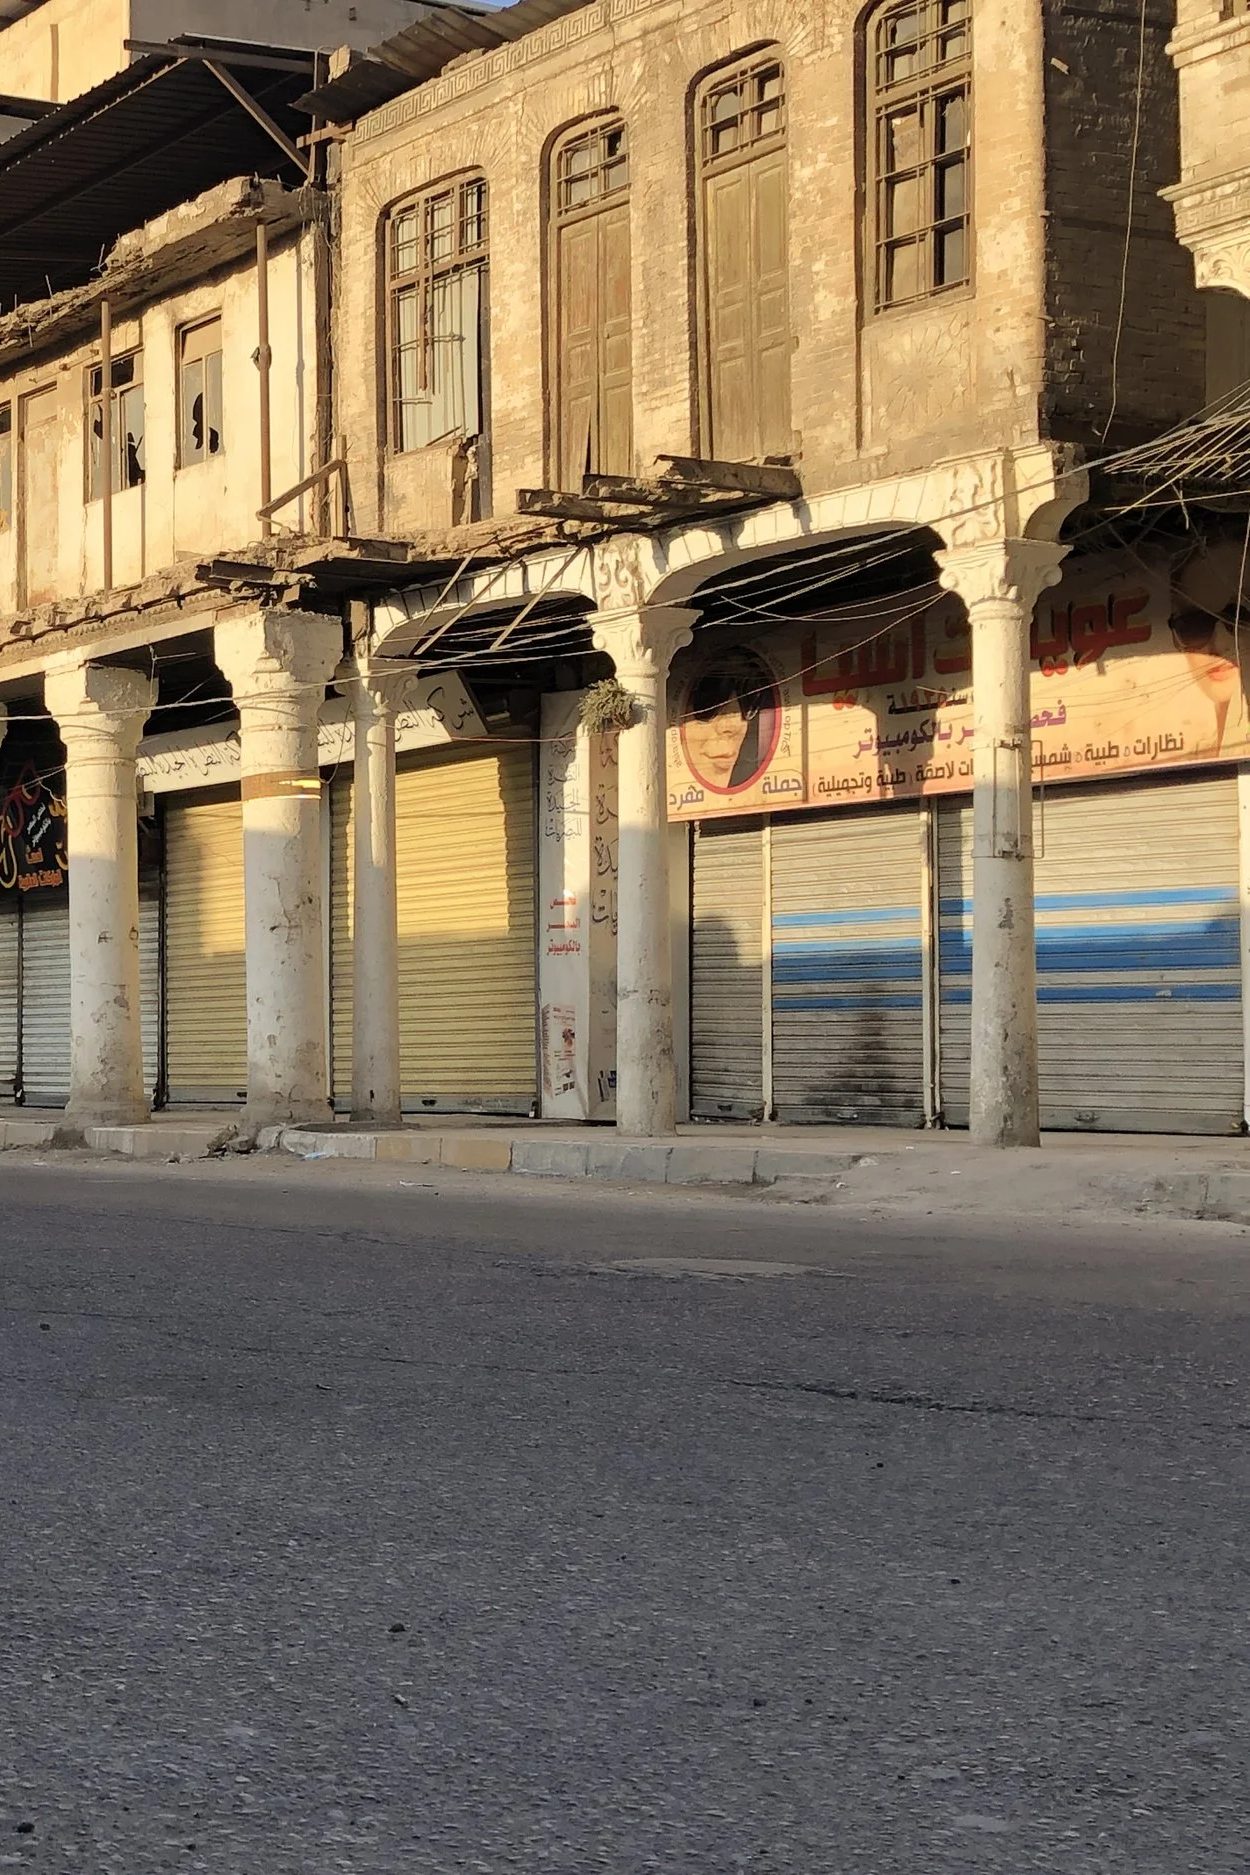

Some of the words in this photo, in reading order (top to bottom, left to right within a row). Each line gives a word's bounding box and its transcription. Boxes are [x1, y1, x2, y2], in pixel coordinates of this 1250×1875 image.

[934, 590, 1151, 678] عويت
[800, 611, 926, 711] اسيا
[852, 718, 954, 759] بالكومبيوتر
[1133, 732, 1184, 761] نظارات
[1031, 743, 1072, 773] شمس
[1084, 741, 1120, 766] طبية
[915, 760, 954, 782] لاصقة
[669, 784, 705, 811] مفرد
[762, 775, 803, 797] جملة
